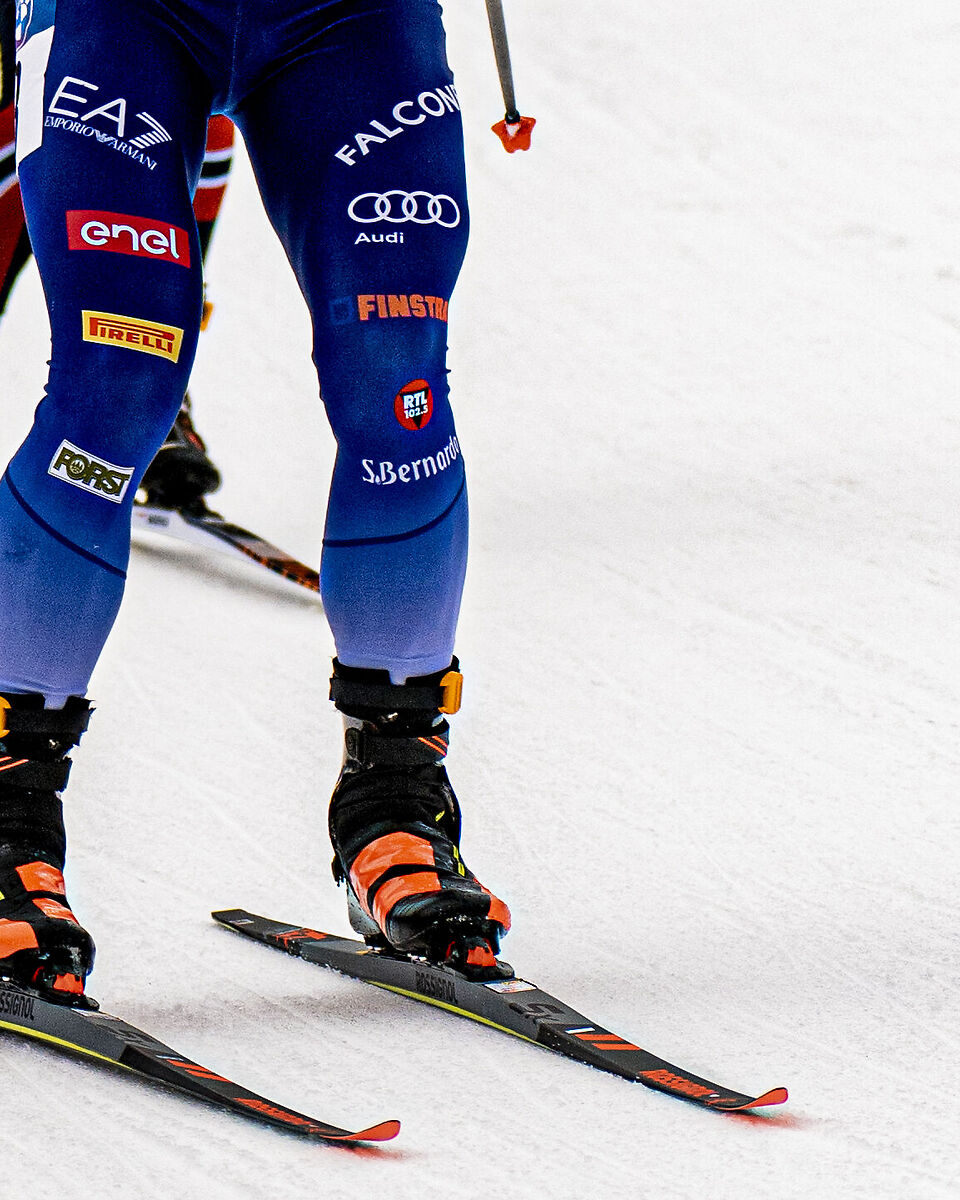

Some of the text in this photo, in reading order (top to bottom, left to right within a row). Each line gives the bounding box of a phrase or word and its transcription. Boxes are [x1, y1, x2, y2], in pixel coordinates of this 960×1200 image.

[48, 75, 173, 150] EA7
[43, 115, 158, 171] EMPORIO ARMANI
[80, 220, 180, 259] enel
[354, 231, 405, 245] Audi
[89, 316, 176, 354] PIRELLI
[402, 390, 429, 410] RTL
[403, 404, 429, 420] 102.5
[52, 446, 132, 497] FORST
